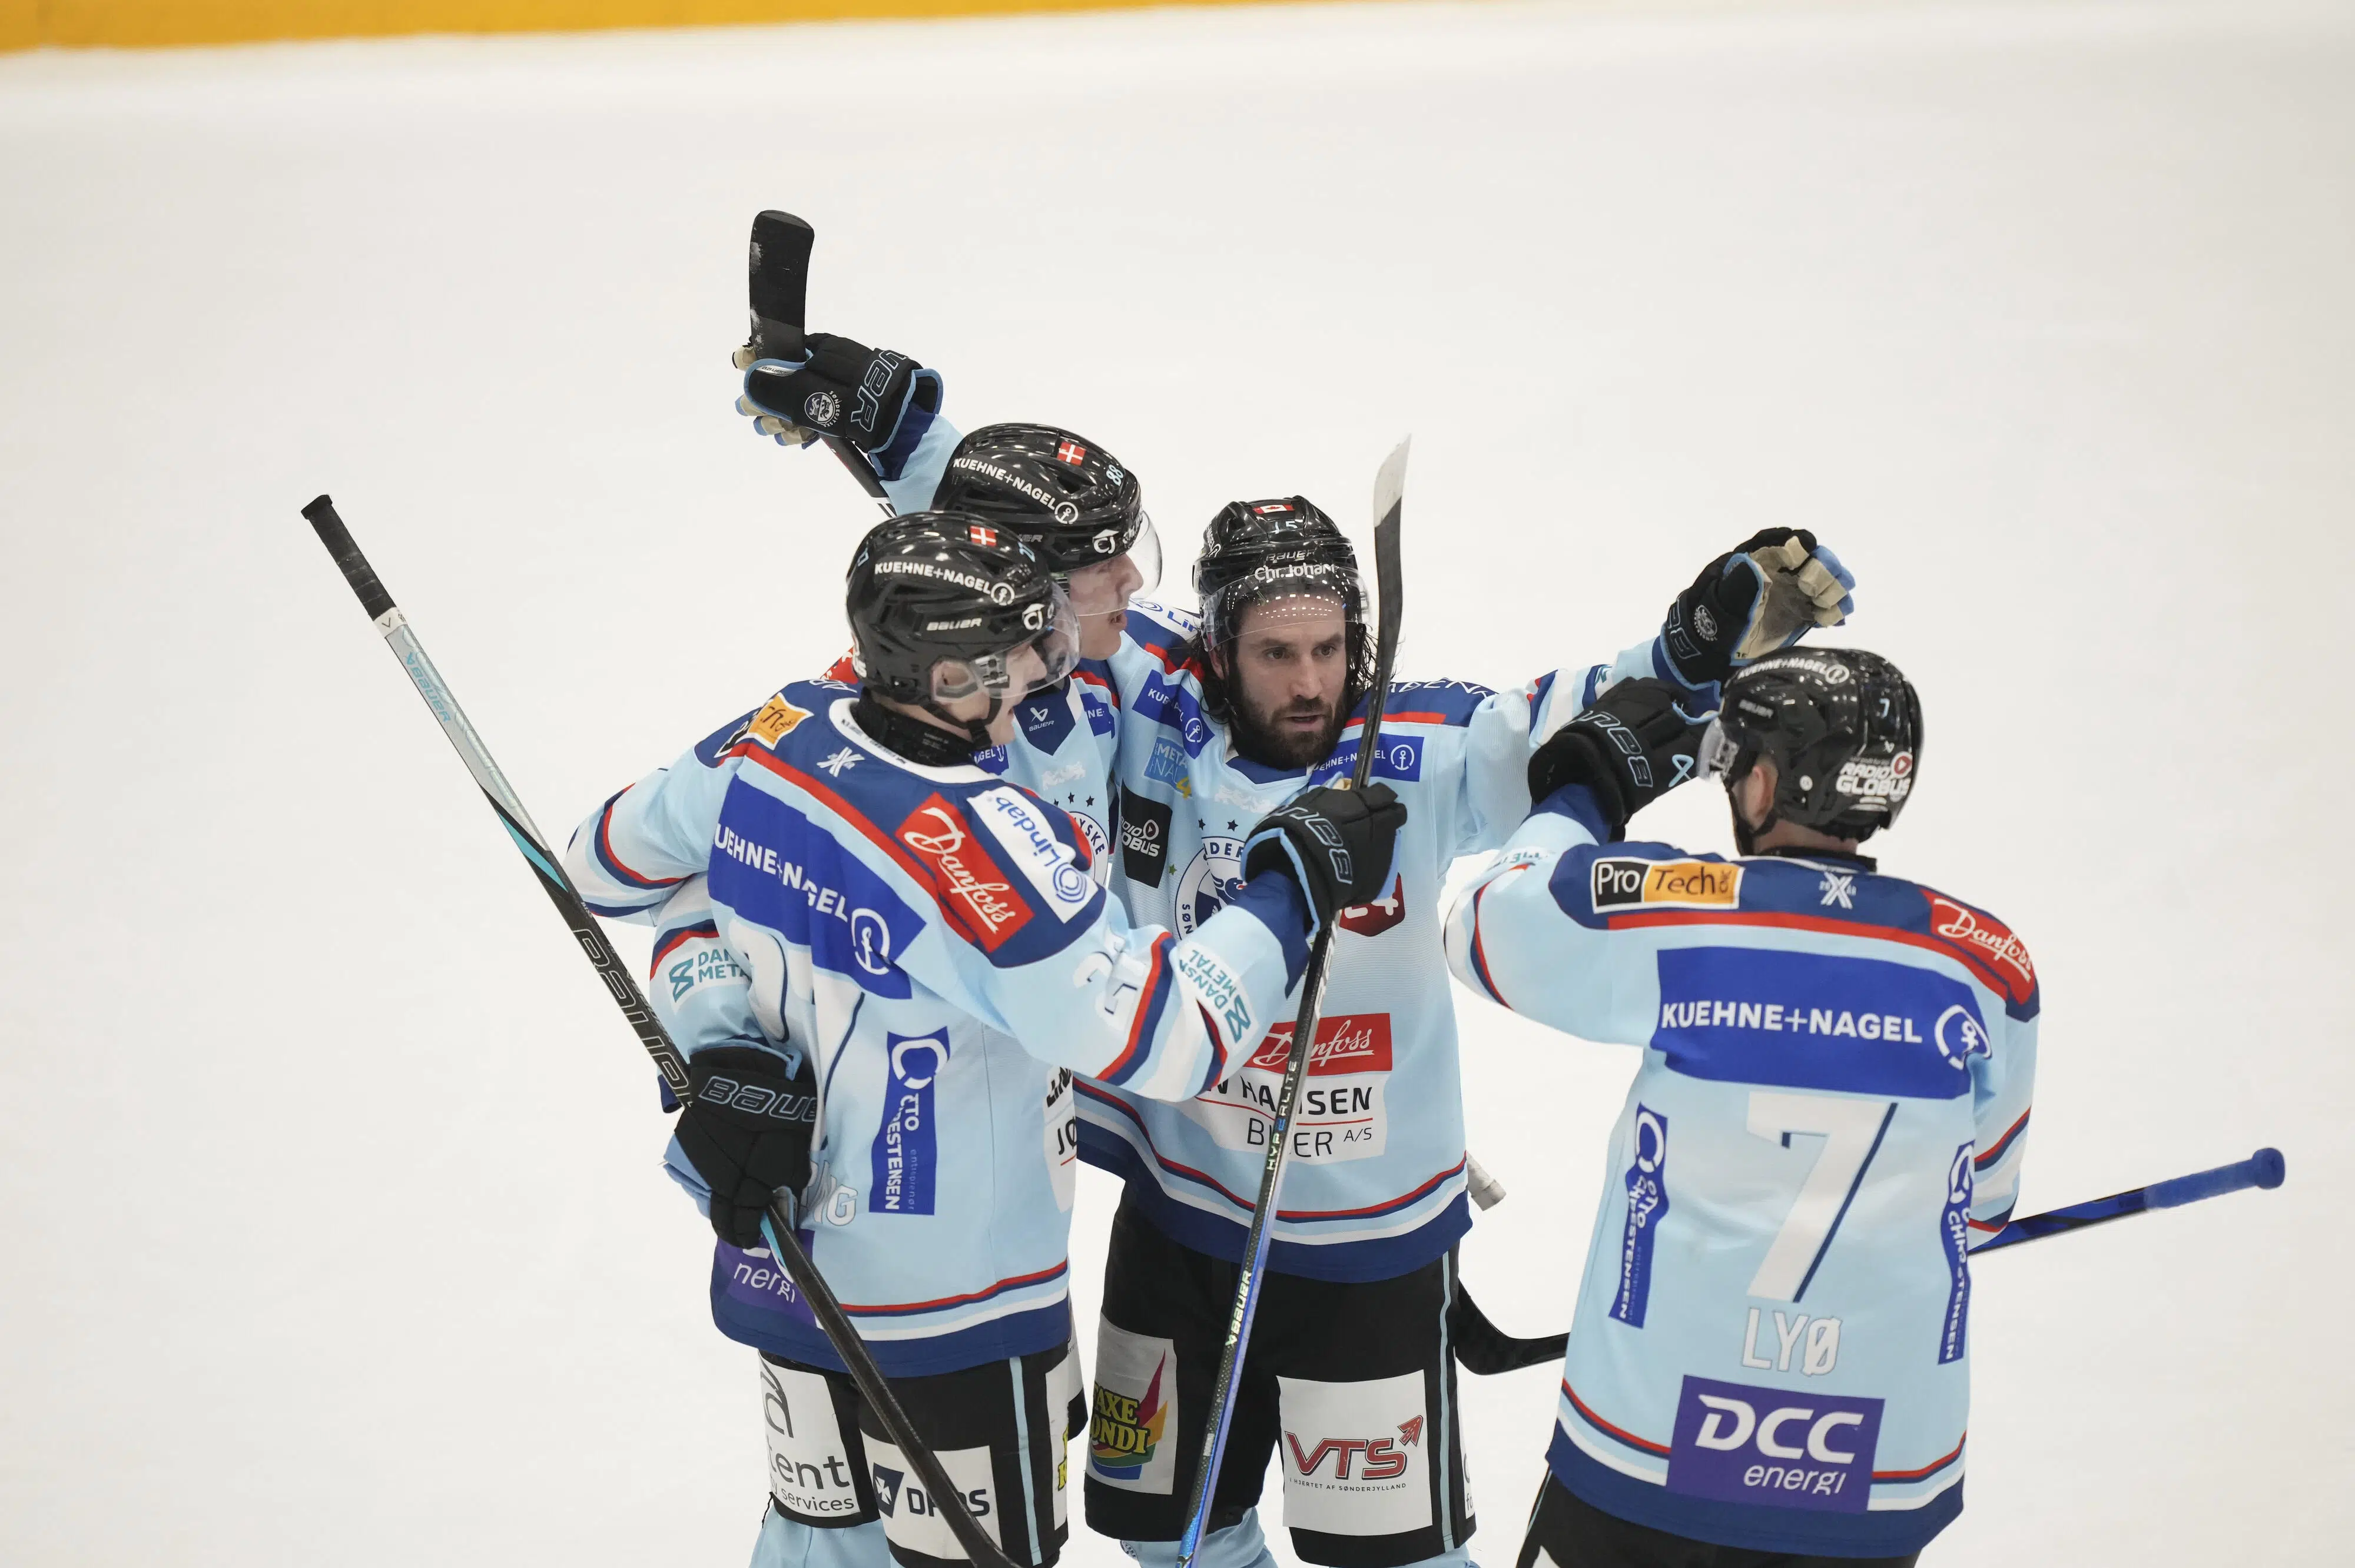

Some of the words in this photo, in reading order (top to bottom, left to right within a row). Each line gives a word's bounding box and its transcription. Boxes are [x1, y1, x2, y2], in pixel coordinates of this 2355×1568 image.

[953, 457, 1056, 510] KUEHNE+NAGEL
[1106, 464, 1124, 486] 88
[874, 562, 991, 595] KUEHNE+NAGEL
[1078, 818, 1105, 855] YSKE
[904, 806, 1016, 936] Danfoss
[1597, 863, 1641, 895] Pro
[1655, 866, 1716, 895] Tech
[1661, 999, 1922, 1044] KUEHNE+NAGEL
[1253, 1019, 1375, 1067] Dnfoss
[1240, 1075, 1373, 1116] HASEN
[1344, 1127, 1372, 1142] A/S
[1746, 1091, 1899, 1304] 7
[1741, 1306, 1843, 1377] LYØ
[1694, 1393, 1865, 1465] DCC
[1284, 1430, 1408, 1481] VTS
[781, 1487, 855, 1511] services
[1293, 1479, 1324, 1490] HJERTET
[1338, 1482, 1407, 1492] SØNDERJYLLAND
[1743, 1464, 1847, 1496] energi
